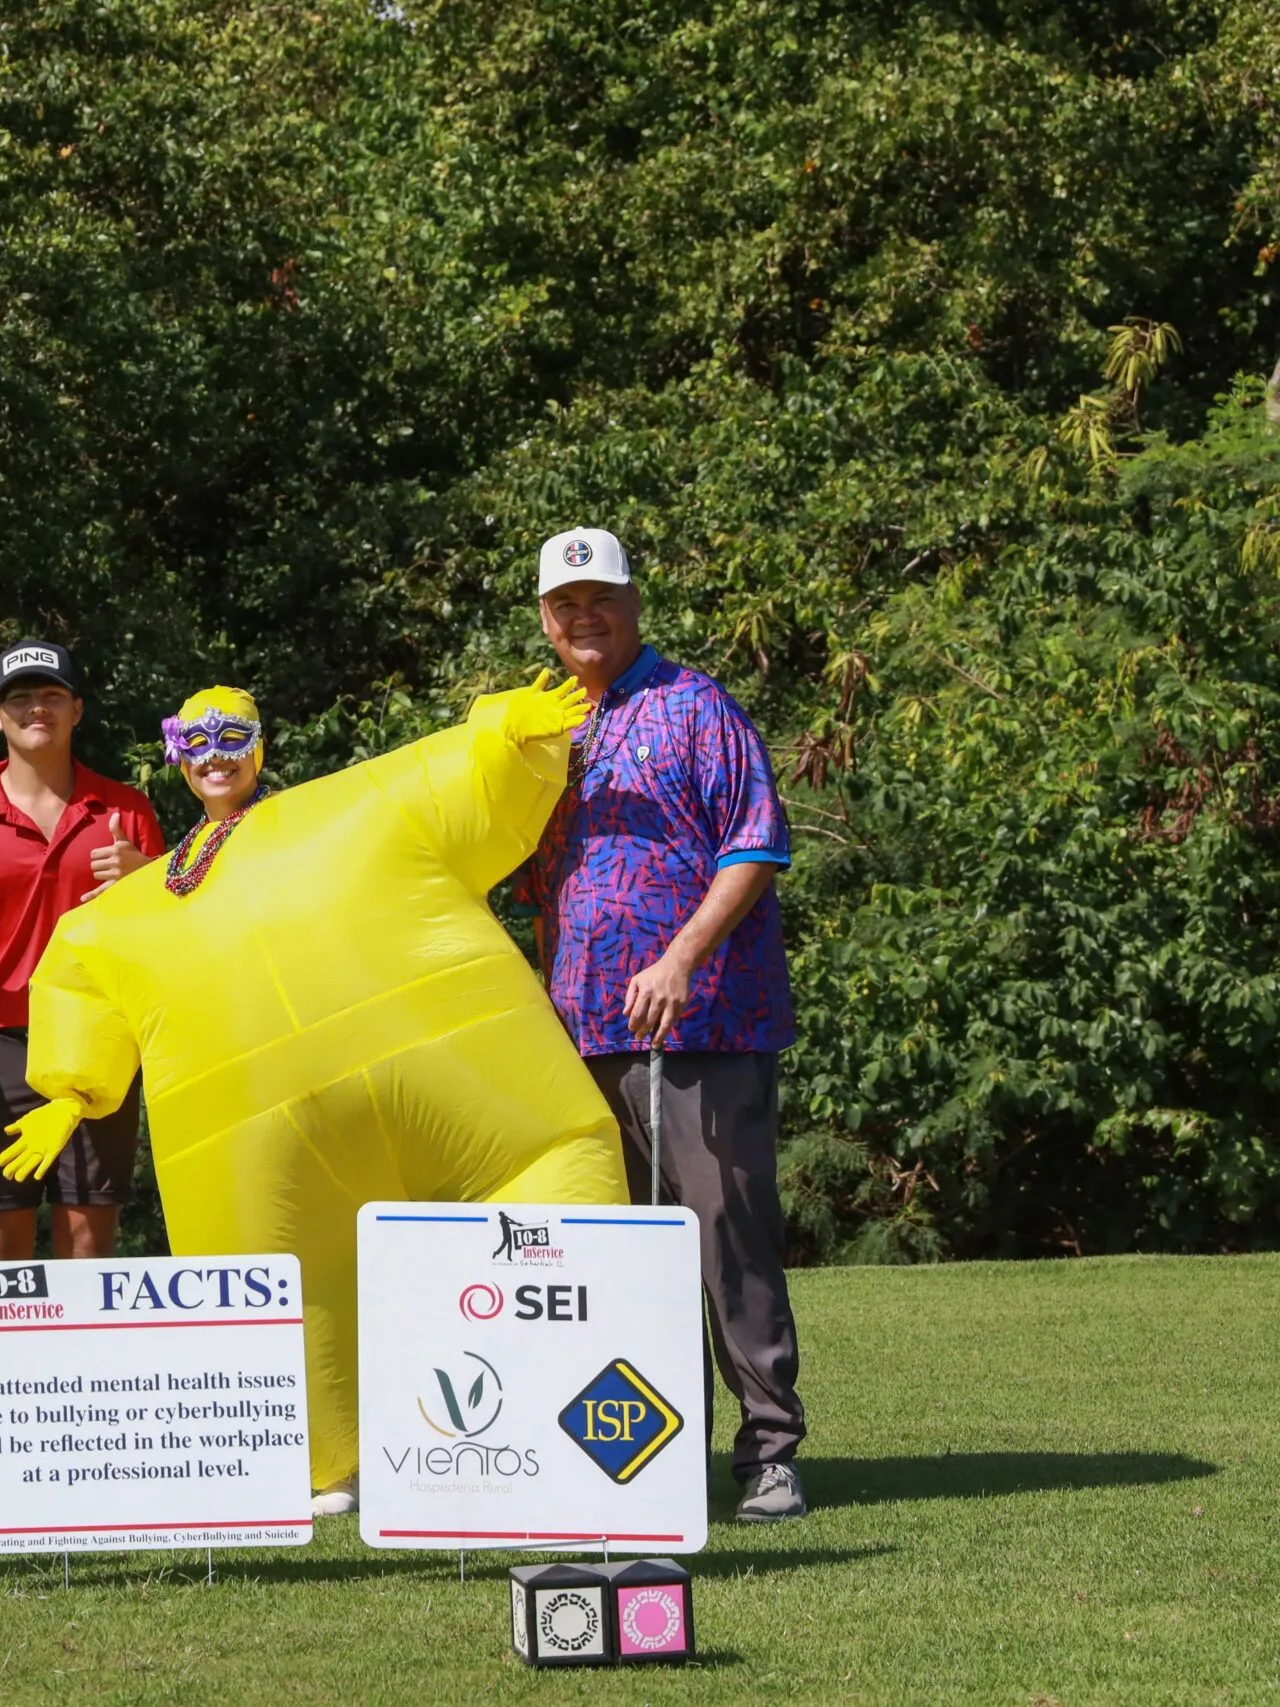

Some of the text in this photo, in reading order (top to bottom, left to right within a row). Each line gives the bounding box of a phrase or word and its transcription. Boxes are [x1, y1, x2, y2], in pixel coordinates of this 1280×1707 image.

[7, 652, 54, 669] PING
[516, 1229, 547, 1246] 10-8
[524, 1247, 564, 1258] InService
[98, 1267, 289, 1311] FACTS:
[515, 1285, 587, 1321] SEI
[90, 1374, 160, 1392] mental
[167, 1372, 230, 1391] health
[238, 1372, 296, 1389] issues
[10, 1408, 29, 1424] to
[36, 1404, 119, 1426] bullying
[126, 1408, 148, 1421] or
[155, 1400, 296, 1424] cyberbullying
[582, 1399, 647, 1441] ISP
[9, 1435, 33, 1453] be
[40, 1432, 126, 1452] reflected
[134, 1432, 153, 1450] in
[160, 1431, 192, 1449] the
[199, 1429, 304, 1451] workplace
[22, 1459, 249, 1486] at a professional level.
[483, 1479, 512, 1493] Rural
[28, 1537, 45, 1546] and
[48, 1536, 87, 1546] Fighting
[91, 1535, 125, 1545] Against
[130, 1533, 171, 1544] Bullying,
[174, 1531, 242, 1543] CyberBullying
[245, 1531, 262, 1540] and
[265, 1530, 299, 1539] Suicide
